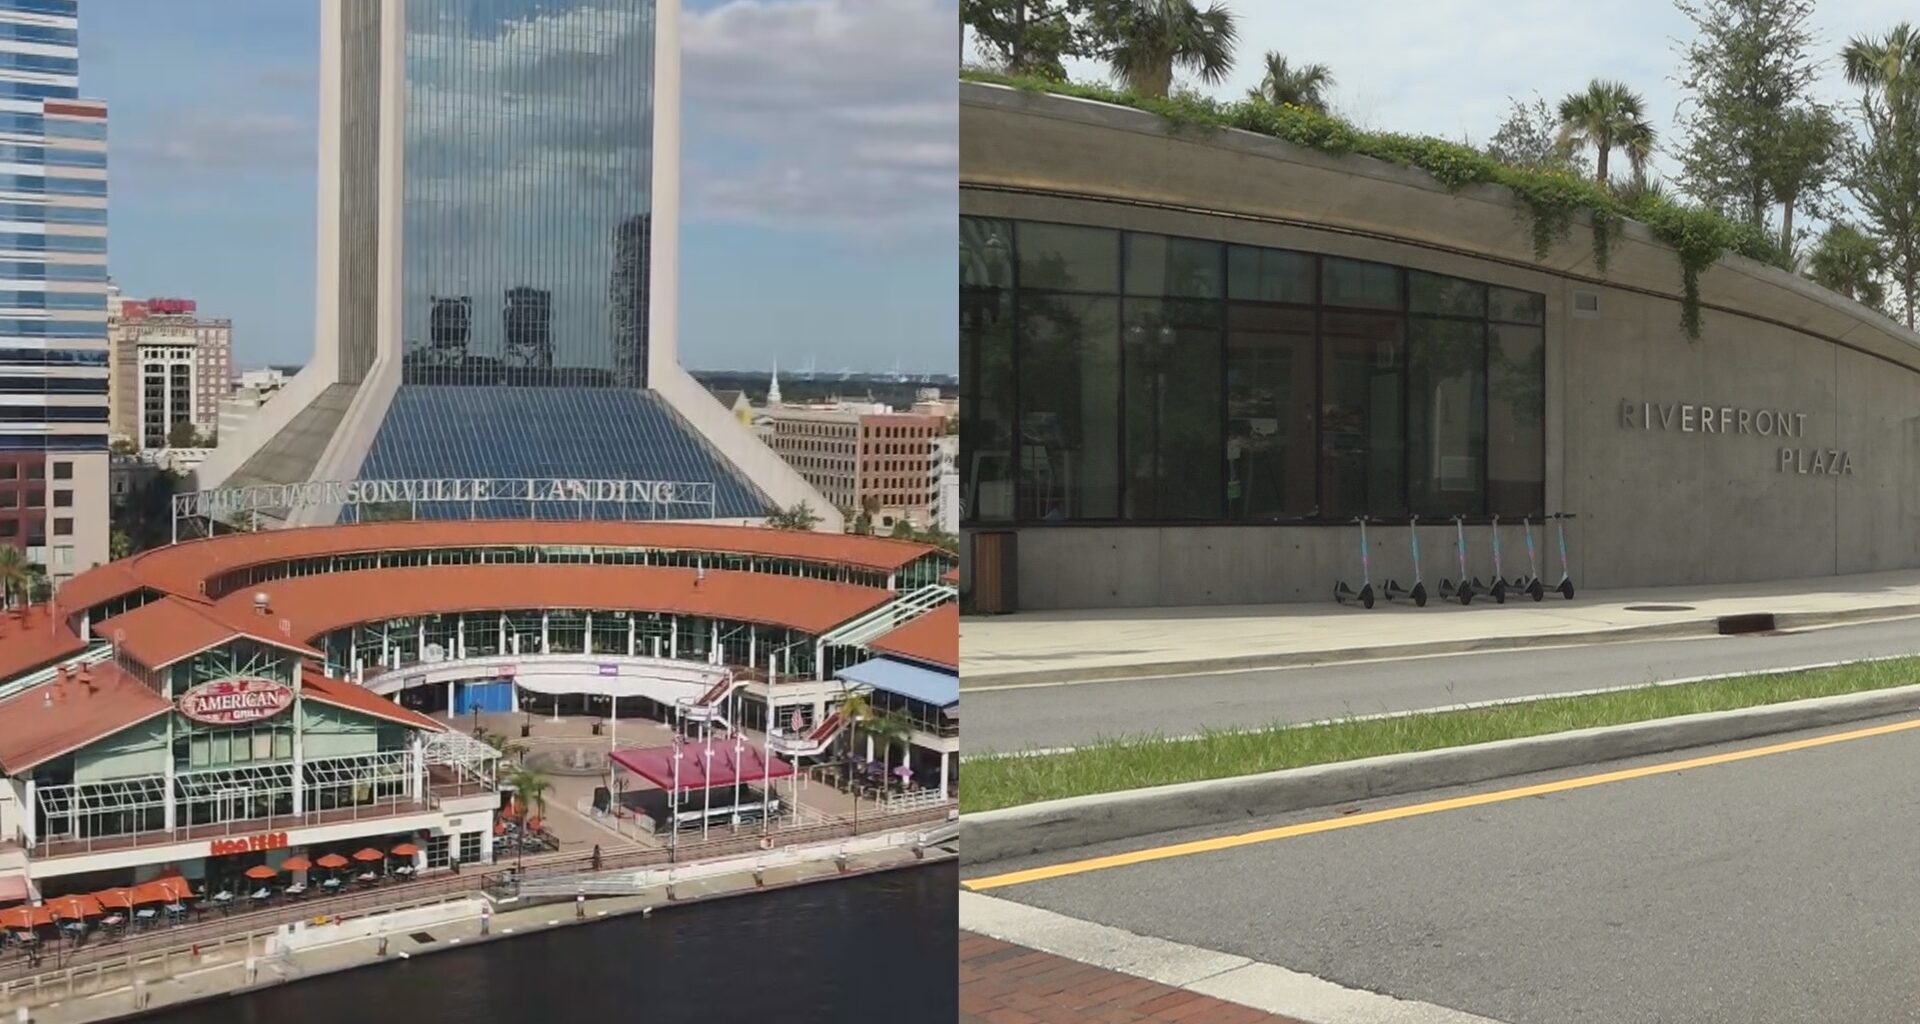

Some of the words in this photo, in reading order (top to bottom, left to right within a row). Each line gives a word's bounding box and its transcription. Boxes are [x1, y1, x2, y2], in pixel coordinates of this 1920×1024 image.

[1620, 400, 1807, 438] RIVERFRONT
[1779, 447, 1853, 475] PLAZA
[276, 478, 489, 508] JACKSONVILLE
[527, 479, 673, 504] LANDING
[196, 690, 280, 712] AMERICAN
[233, 708, 261, 719] GRILL
[211, 832, 288, 855] HOOTERS
